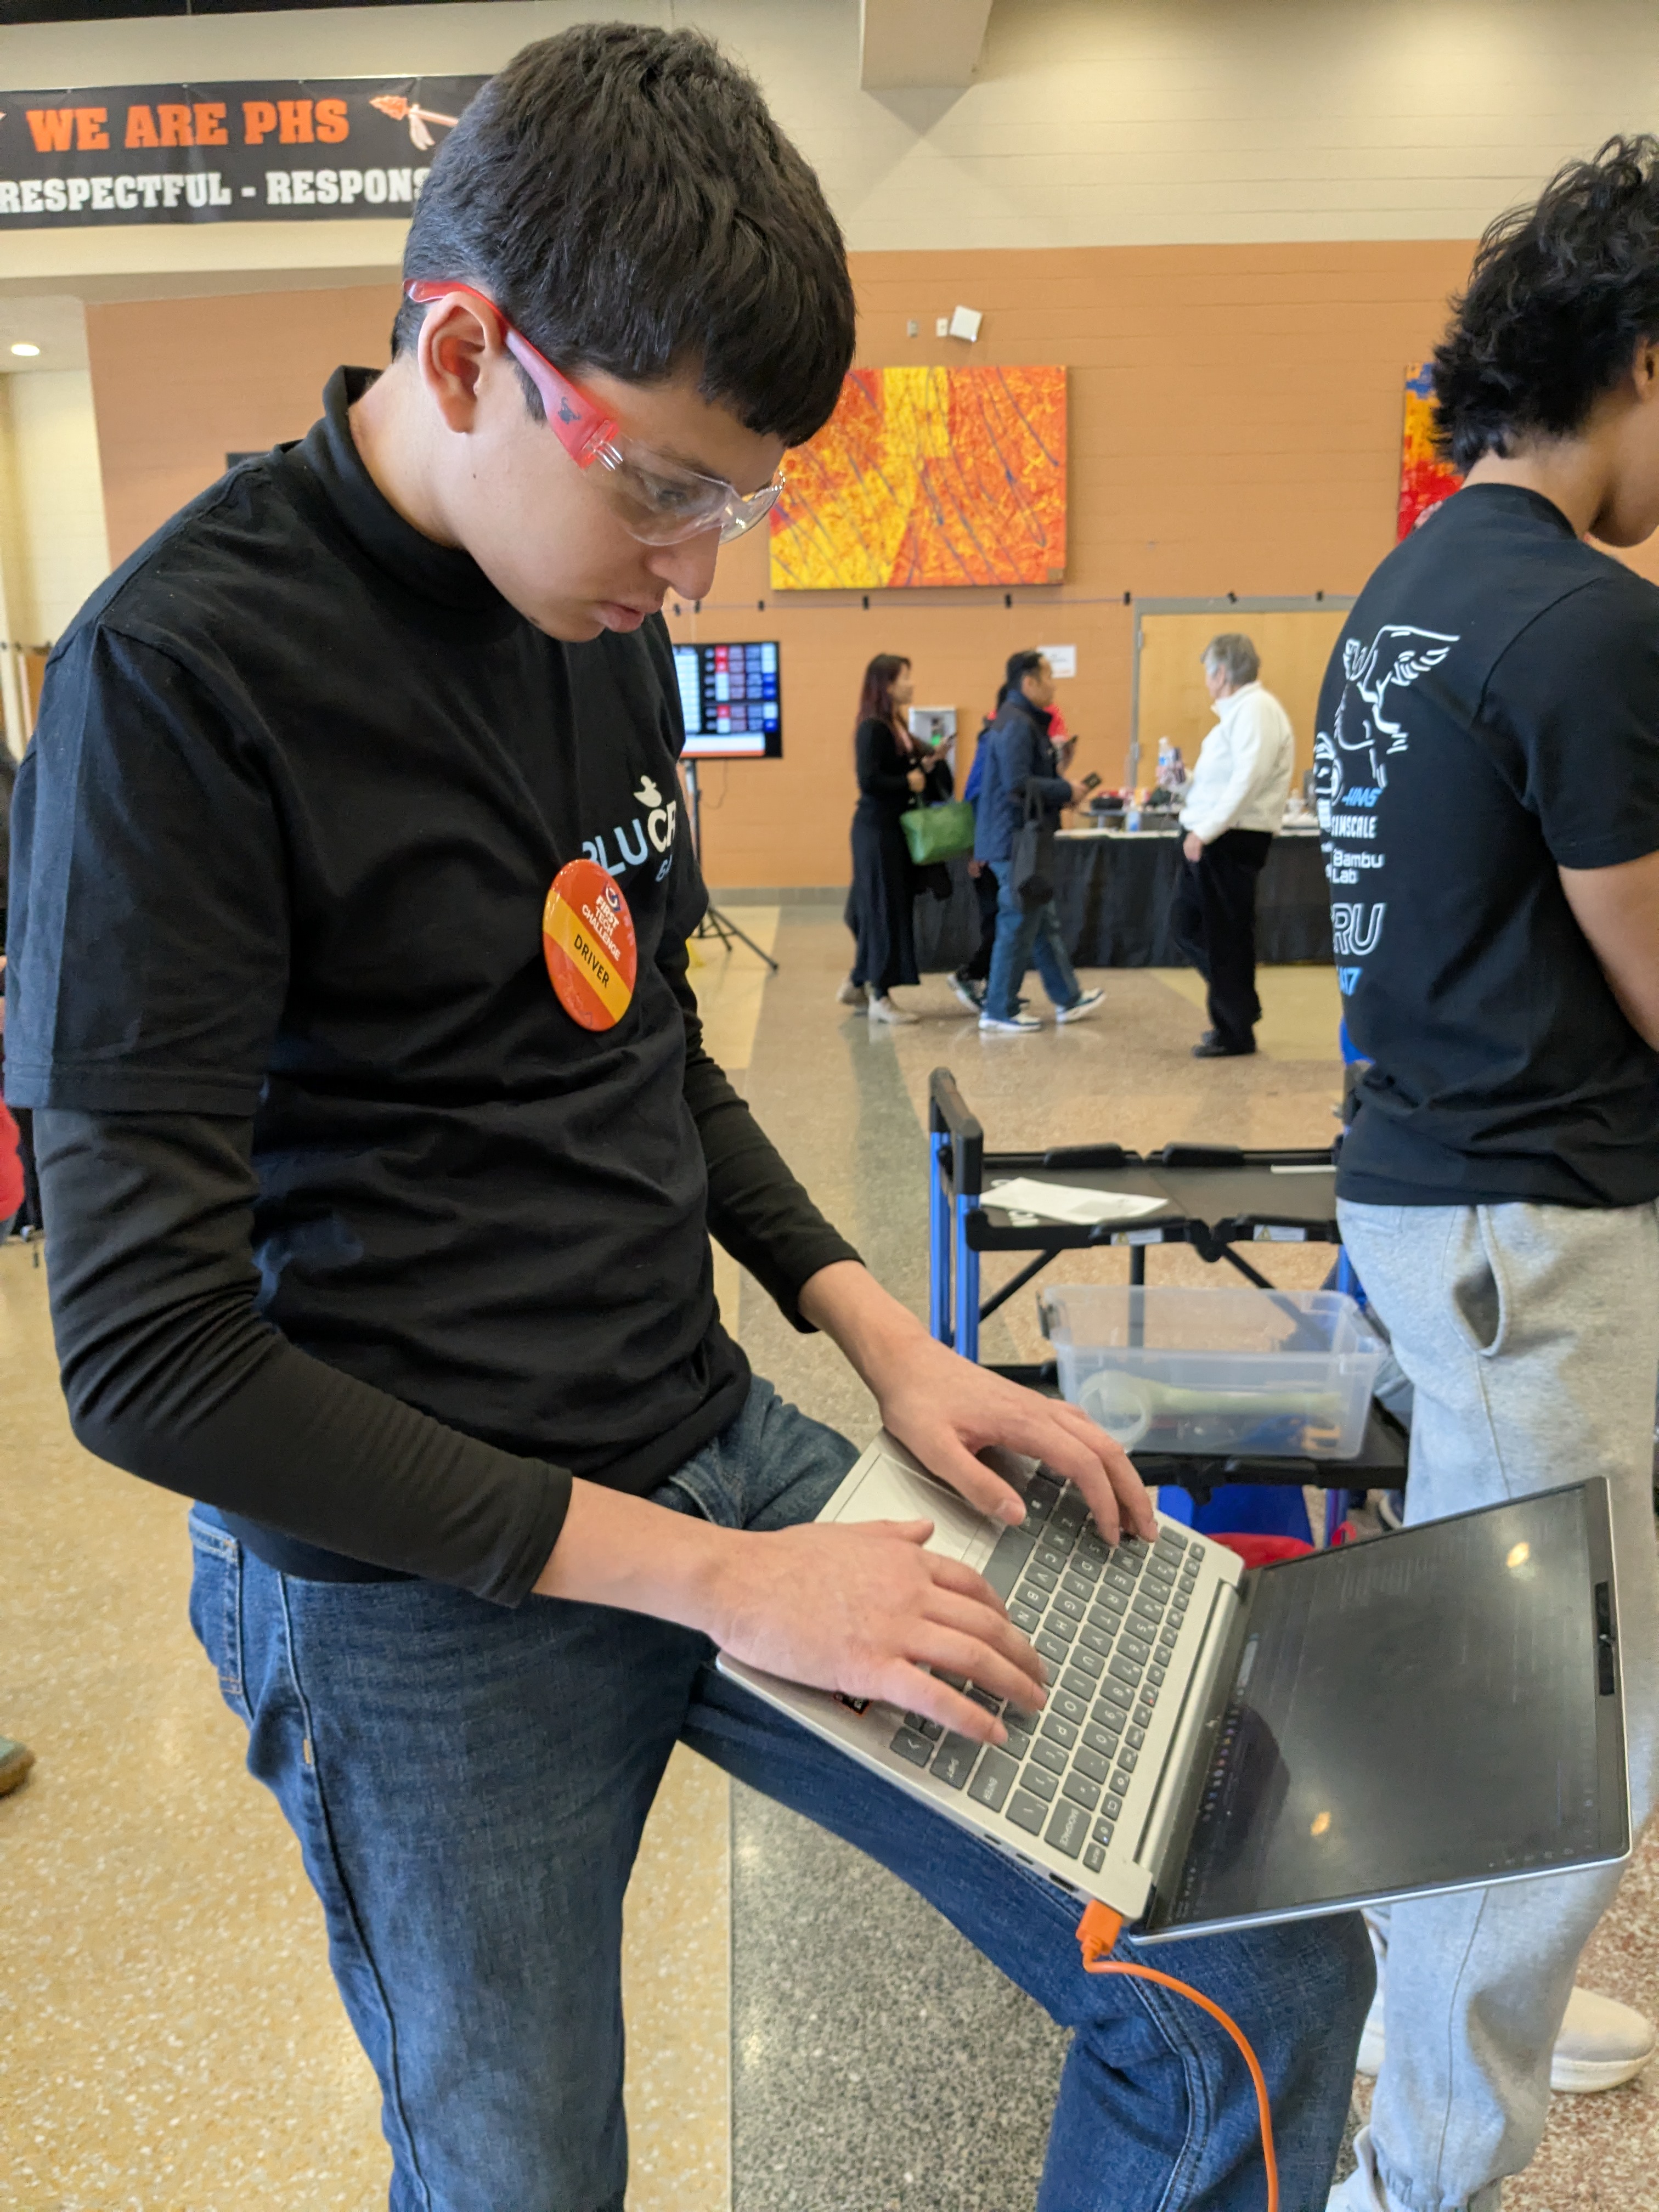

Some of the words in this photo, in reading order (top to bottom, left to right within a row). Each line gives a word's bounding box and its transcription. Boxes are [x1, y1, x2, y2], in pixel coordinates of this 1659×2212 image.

[26, 107, 109, 153] WE
[125, 103, 228, 149] ARE
[242, 98, 349, 144] PHS
[0, 172, 232, 213] RESPECTFUL
[1333, 848, 1385, 868] Bambu
[1332, 867, 1358, 884] Lab
[596, 895, 619, 927] FIRST
[596, 906, 613, 936] TECH
[582, 904, 621, 961] CHALLENGE
[574, 934, 610, 988] DRIVER
[1046, 1554, 1056, 1562] C
[1082, 1561, 1093, 1571] D
[1115, 1575, 1126, 1584] E
[1075, 1582, 1084, 1590] F
[1028, 1591, 1039, 1600] B
[1108, 1594, 1119, 1603] R
[1064, 1601, 1075, 1610] G
[1057, 1620, 1066, 1630] H
[1092, 1637, 1103, 1645] Y
[1047, 1642, 1057, 1651] J
[1083, 1656, 1094, 1666] U
[1105, 1711, 1115, 1719] 9
[1057, 1725, 1066, 1735] P
[984, 1778, 997, 1800] ENTER
[1060, 1808, 1079, 1846] BACKSPACE
